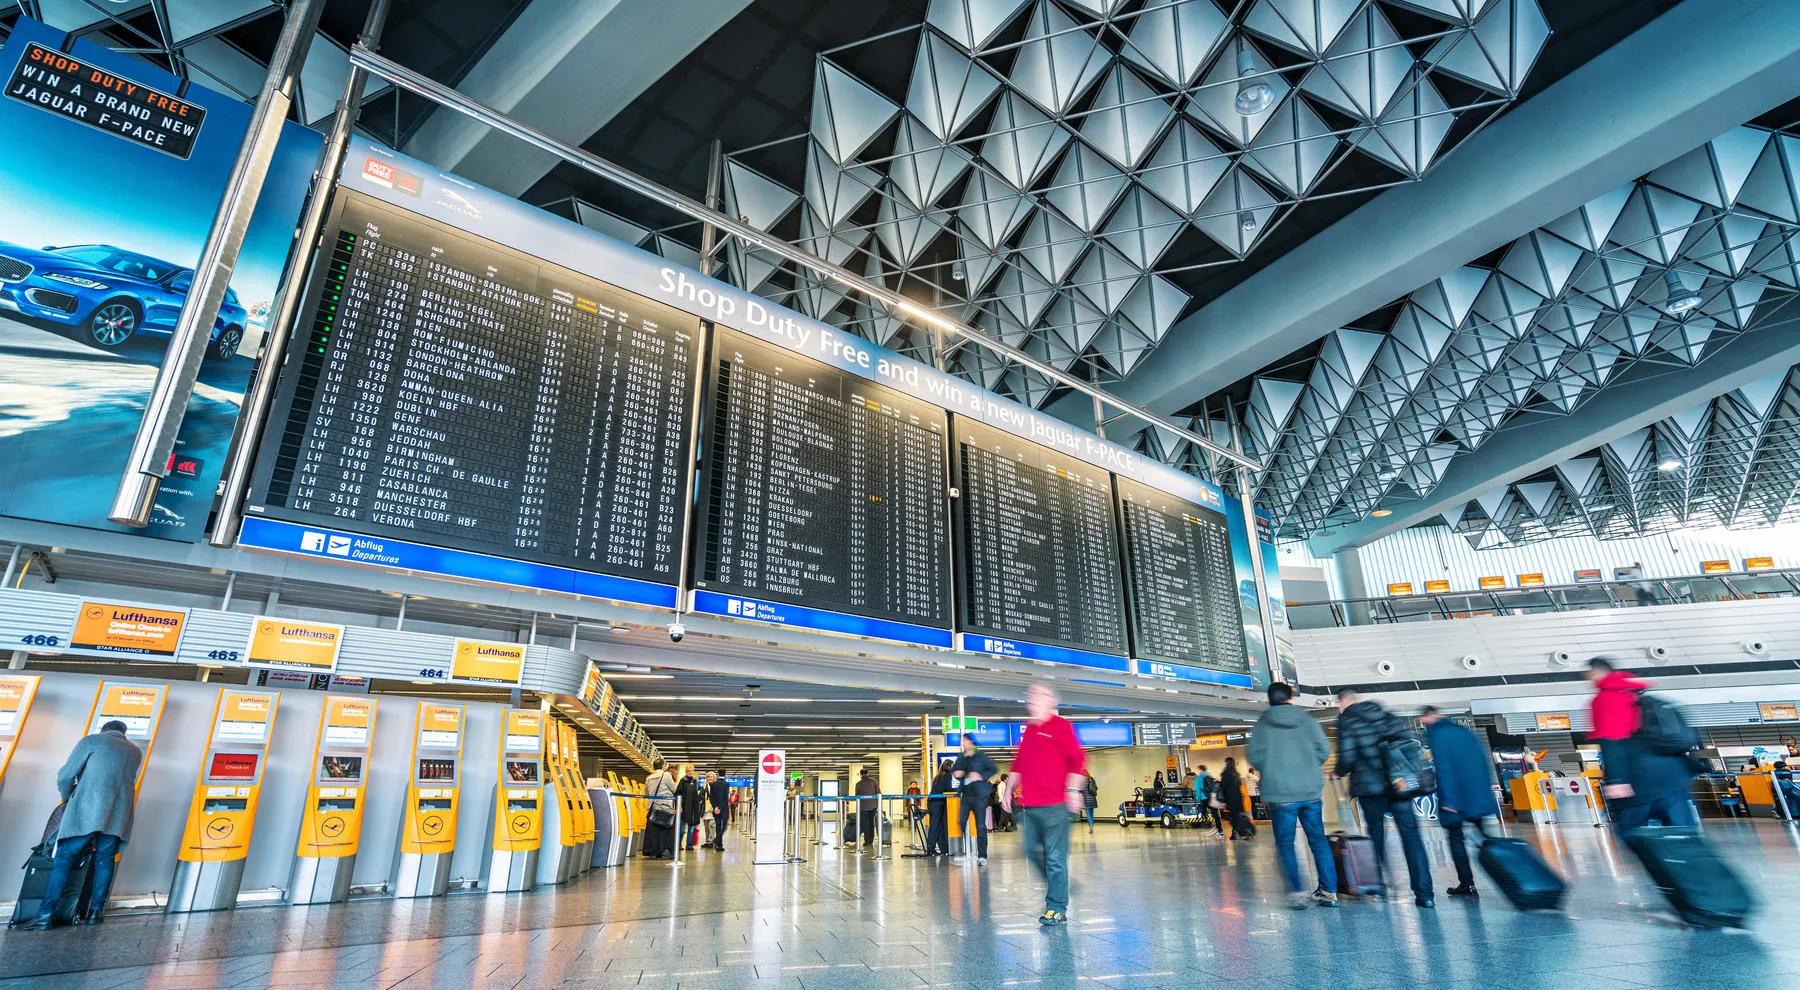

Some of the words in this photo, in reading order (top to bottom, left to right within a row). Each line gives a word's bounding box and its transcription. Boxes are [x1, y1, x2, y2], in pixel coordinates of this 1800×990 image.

[30, 48, 80, 73] SHOP
[90, 71, 137, 96] DUTY
[147, 93, 190, 116] FREE
[23, 64, 60, 87] WIN
[70, 86, 81, 96] A
[94, 93, 150, 121] BRAND
[161, 117, 195, 137] NEW
[13, 83, 87, 118] JAGUAR
[99, 113, 166, 146] F-PACE
[368, 167, 391, 179] FREE
[369, 161, 393, 174] DUTY
[360, 249, 373, 260] TK
[388, 258, 414, 272] 1592
[428, 271, 522, 308] ISTANBUL-ATATURK
[362, 239, 376, 250] PC
[396, 251, 415, 263] 334
[429, 261, 518, 298] ISTANBUL-SABIHA
[355, 268, 370, 279] LH
[390, 280, 409, 292] 190
[422, 290, 495, 320] BERLIN-TEGEL
[350, 288, 370, 301] TUA
[384, 300, 404, 311] 464
[417, 309, 468, 330] ASHGABAT
[352, 278, 367, 289] LH
[387, 288, 406, 301] 274
[419, 299, 505, 332] MAILAND-LINATE
[347, 298, 362, 309] LH
[376, 306, 402, 321] 1240
[414, 319, 442, 333] WIEN
[344, 309, 360, 319] LH
[380, 318, 400, 331] 138
[412, 328, 495, 358] ROM-FIUMICINO
[338, 329, 354, 340] LH
[374, 339, 395, 351] 914
[408, 348, 504, 381] LONDON-HEATHROW
[342, 319, 357, 329] LH
[377, 329, 397, 341] 804
[410, 338, 516, 375] STOCKHOLM-ARLANDA
[332, 351, 348, 361] QR
[369, 360, 390, 372] 068
[403, 369, 430, 383] DOHA
[336, 340, 351, 350] LH
[366, 348, 392, 362] 1132
[406, 359, 465, 381] BARCELONA
[659, 267, 735, 319] Shop
[746, 300, 811, 349] Duty
[820, 330, 870, 368] Free
[878, 359, 918, 387] and
[926, 378, 962, 405] win
[969, 396, 980, 408] a
[986, 401, 1024, 427] new
[1030, 414, 1081, 451] Jaguar
[1086, 438, 1134, 472] F-PACE
[327, 372, 343, 383] LH
[356, 379, 385, 393] 3620
[398, 390, 433, 405] KOELN
[438, 400, 459, 411] HBF
[330, 361, 345, 372] RJ
[368, 371, 388, 383] 126
[400, 380, 473, 405] AMMAN-QUEEN
[479, 400, 504, 413] ALIA
[774, 388, 808, 403] AMSTERDAM
[322, 394, 337, 405] LH
[352, 402, 380, 415] 1222
[394, 412, 421, 424] GENF
[324, 383, 340, 394] LH
[362, 393, 383, 404] 980
[396, 401, 438, 418] DUBLIN
[774, 403, 804, 418] BUDAPEST
[316, 417, 331, 427] SV
[355, 426, 375, 437] 168
[390, 433, 431, 449] JEDDAH
[319, 406, 334, 416] LH
[350, 413, 378, 426] 1350
[391, 422, 446, 441] WARSCHAU
[313, 428, 328, 438] LH
[350, 437, 372, 448] 956
[387, 445, 455, 466] BIRMINGHAM
[772, 434, 799, 448] BOLOGNA
[772, 443, 792, 454] TURIN
[307, 451, 322, 462] LH
[338, 458, 367, 470] 1196
[381, 467, 431, 484] ZUERICH
[310, 440, 325, 450] LH
[342, 446, 370, 459] 1040
[384, 455, 419, 469] PARIS
[426, 463, 444, 474] CH.
[453, 470, 465, 479] DE
[472, 474, 510, 489] GAULLE
[772, 452, 799, 464] FLORENZ
[303, 464, 319, 473] AT
[342, 471, 364, 482] 811
[379, 478, 449, 499] CASABLANCA
[770, 476, 817, 494] BERLIN-TEGEL
[771, 468, 790, 479] SANKT
[795, 475, 832, 490] PETERSBURG
[301, 475, 316, 485] LH
[340, 483, 362, 494] 946
[376, 489, 447, 511] MANCHESTER
[769, 485, 790, 495] NIZZA
[769, 494, 793, 505] KRAKAU
[295, 500, 310, 510] LH
[334, 507, 356, 519] 264
[372, 514, 415, 528] VERONA
[298, 487, 313, 498] LH
[329, 493, 359, 507] 3518
[374, 502, 450, 523] DUESSELDORF
[458, 517, 478, 528] HBF
[769, 502, 813, 518] DUESSELDORF
[768, 520, 785, 529] WIEN
[768, 529, 784, 538] PRAG
[354, 540, 383, 551] Abflug
[767, 547, 783, 556] GRAZ
[768, 538, 823, 555] MINSK-NATIONAL
[352, 550, 399, 564] Departures
[767, 556, 804, 569] STUTTGART
[766, 565, 787, 574] PALMA
[804, 572, 835, 584] MALLORCA
[766, 574, 799, 586] SALZBURG
[766, 583, 803, 596] INNSBRUCK
[113, 611, 178, 625] Lufthansa
[757, 612, 785, 622] Departures
[758, 604, 775, 613] Abflug
[22, 634, 58, 646] 466
[282, 627, 335, 640] Lufthansa
[208, 650, 238, 661] 465
[478, 647, 520, 658] Lufthansa
[420, 669, 443, 678] 464
